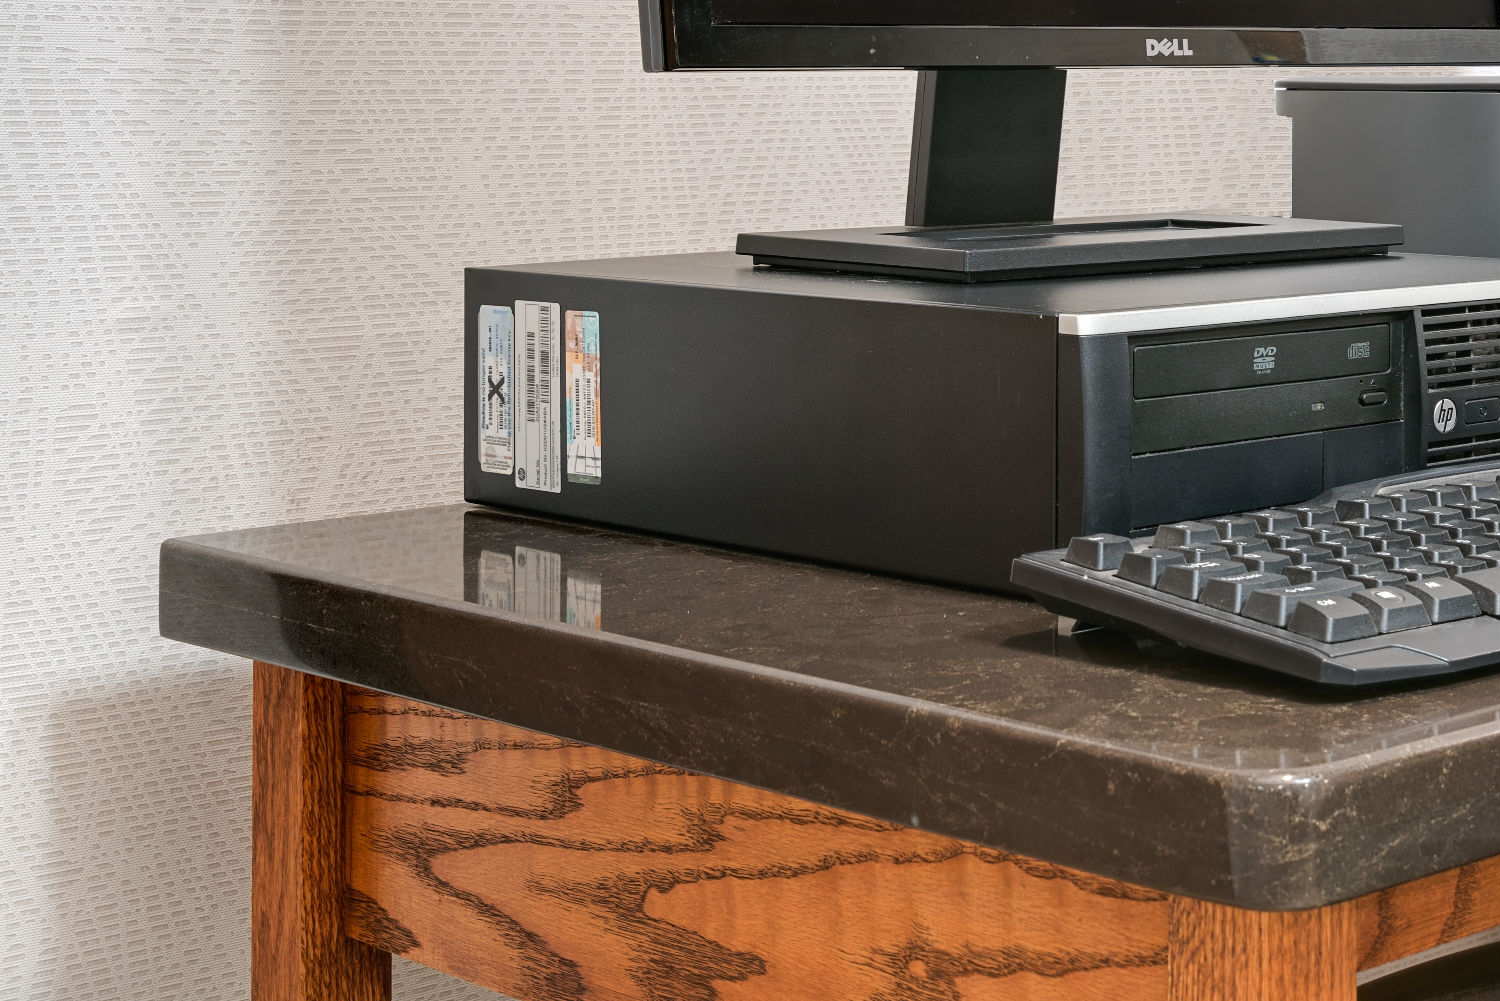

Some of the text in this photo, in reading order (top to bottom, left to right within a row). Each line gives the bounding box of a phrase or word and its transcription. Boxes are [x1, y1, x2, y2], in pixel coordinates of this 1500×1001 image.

[1145, 37, 1193, 56] DELL
[1254, 347, 1277, 357] DVD
[1348, 344, 1370, 359] disc
[1437, 399, 1454, 433] hp
